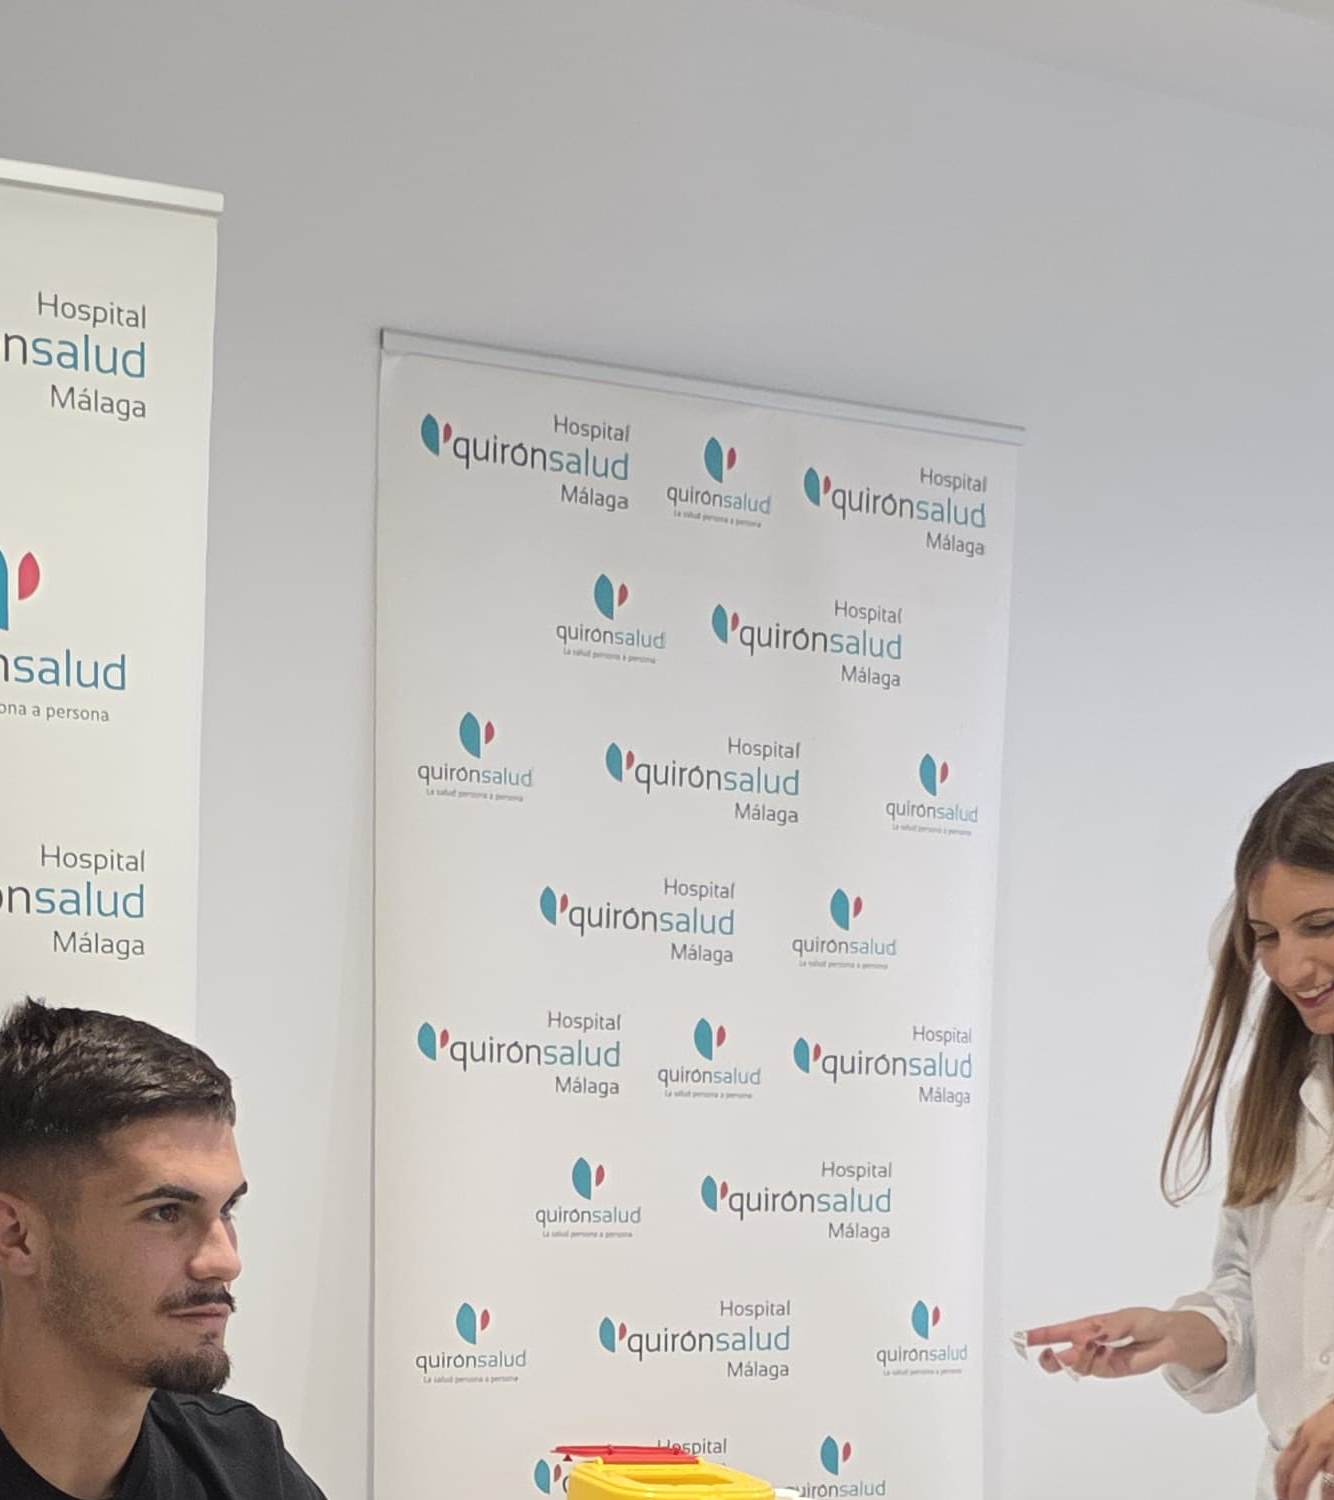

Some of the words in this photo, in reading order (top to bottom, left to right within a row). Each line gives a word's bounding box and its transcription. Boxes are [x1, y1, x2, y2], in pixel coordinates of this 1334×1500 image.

[38, 291, 146, 329] Hospital
[51, 384, 145, 421] Málaga
[554, 414, 630, 442] Hospital
[453, 434, 630, 480] quirónsalud
[920, 467, 987, 493] Hospital
[561, 484, 629, 512] Málaga
[667, 486, 771, 516] quirónsalud
[832, 487, 986, 528] quirónsalud
[926, 531, 985, 558] Málaga
[835, 600, 902, 624] Hospital
[556, 624, 666, 650] quirónsalud
[740, 622, 901, 659] quirónsalud
[842, 664, 900, 690] Málaga
[32, 706, 40, 716] a
[46, 707, 109, 722] persona
[728, 736, 801, 761] Hospital
[418, 763, 532, 787] quirónsalud
[635, 760, 799, 796] quirónsalud
[735, 802, 798, 826] Málaga
[886, 800, 978, 823] quirónsalud
[41, 843, 144, 875] Hospital
[664, 877, 735, 901] Hospital
[569, 902, 734, 937] quirónsalud
[54, 930, 144, 960] Málaga
[671, 942, 733, 966] Málaga
[792, 936, 896, 958] quirónsalud
[548, 1011, 621, 1033] Hospital
[912, 1025, 971, 1046] Hospital
[450, 1039, 620, 1072] quirónsalud
[822, 1050, 971, 1084] quirónsalud
[556, 1076, 619, 1098] Málaga
[658, 1066, 761, 1088] quirónsalud
[919, 1086, 970, 1107] Málaga
[821, 1161, 892, 1182] Hospital
[729, 1187, 891, 1221] quirónsalud
[536, 1206, 641, 1228] quirónsalud
[829, 1222, 890, 1242] Málaga
[720, 1300, 790, 1320] Hospital
[628, 1325, 789, 1362] quirónsalud
[416, 1350, 526, 1374] quirónsalud
[877, 1345, 967, 1368] quirónsalud
[728, 1361, 789, 1380] Málaga
[785, 1479, 886, 1498] irónsalud
